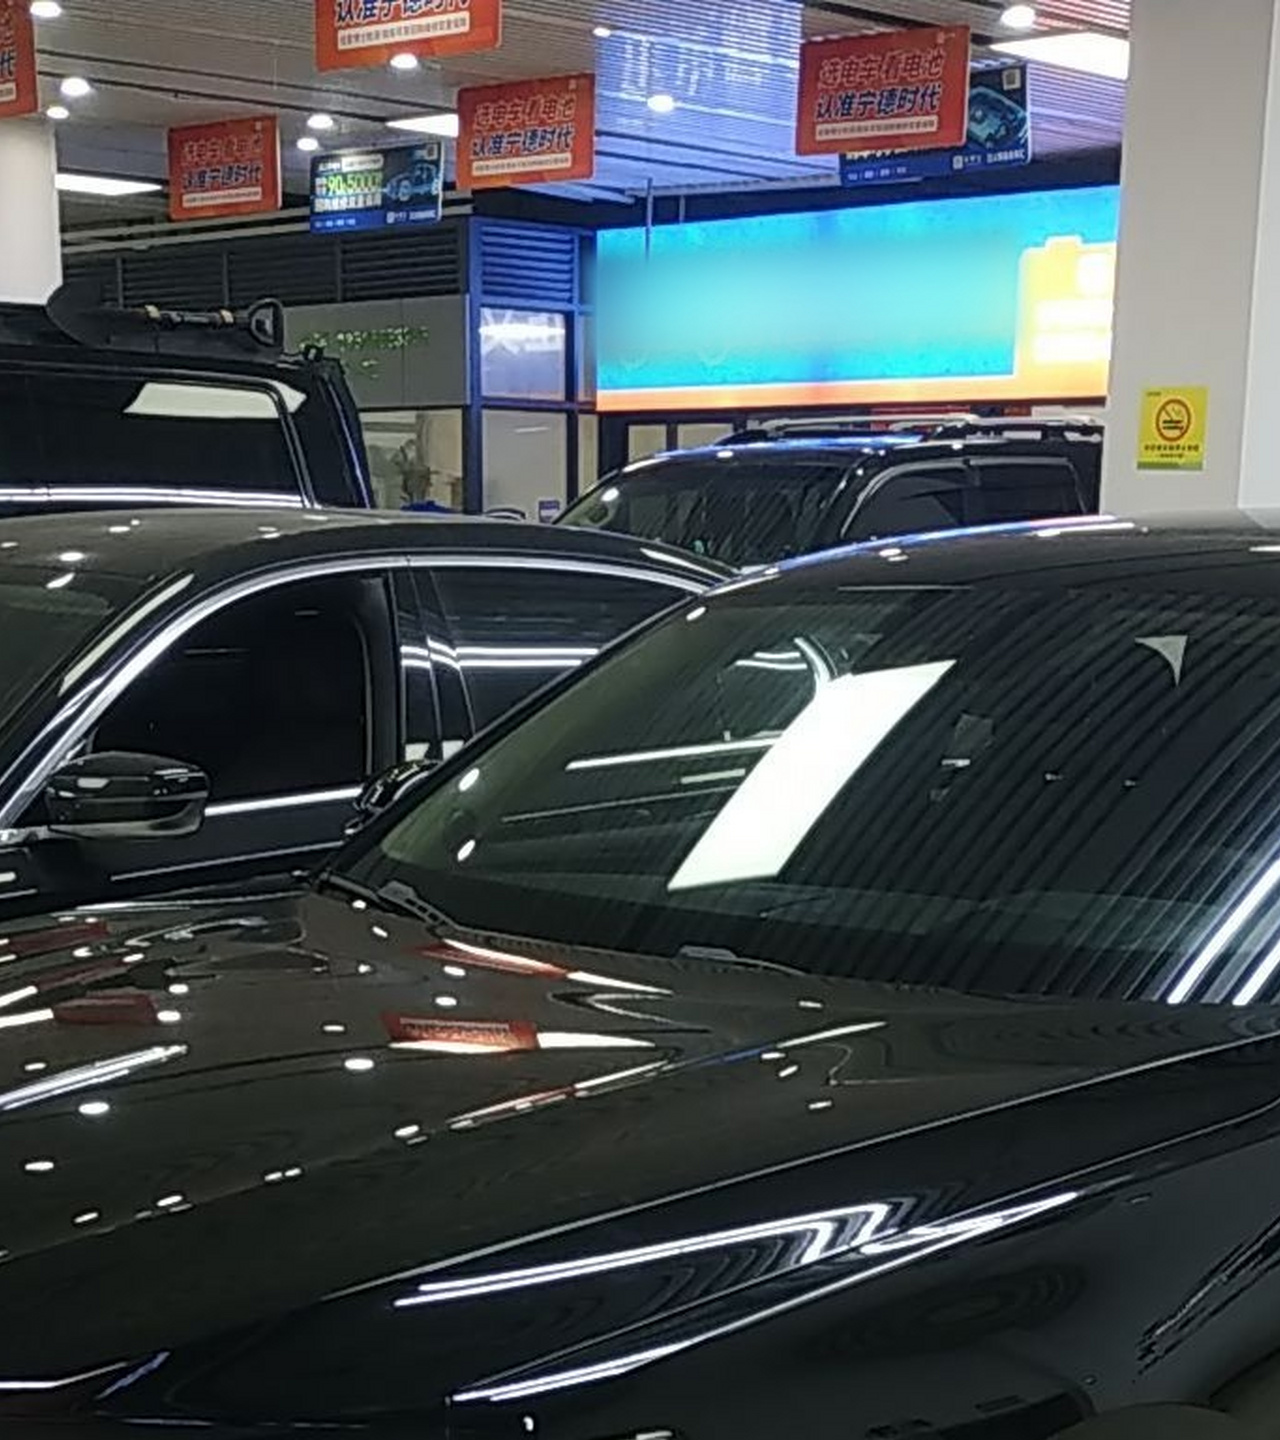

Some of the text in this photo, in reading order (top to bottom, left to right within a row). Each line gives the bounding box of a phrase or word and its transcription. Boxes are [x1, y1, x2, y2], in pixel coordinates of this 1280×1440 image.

[817, 44, 946, 89] 选电车看电池
[815, 82, 941, 121] 认准宁德时代
[472, 123, 574, 158] 认准宁德时代
